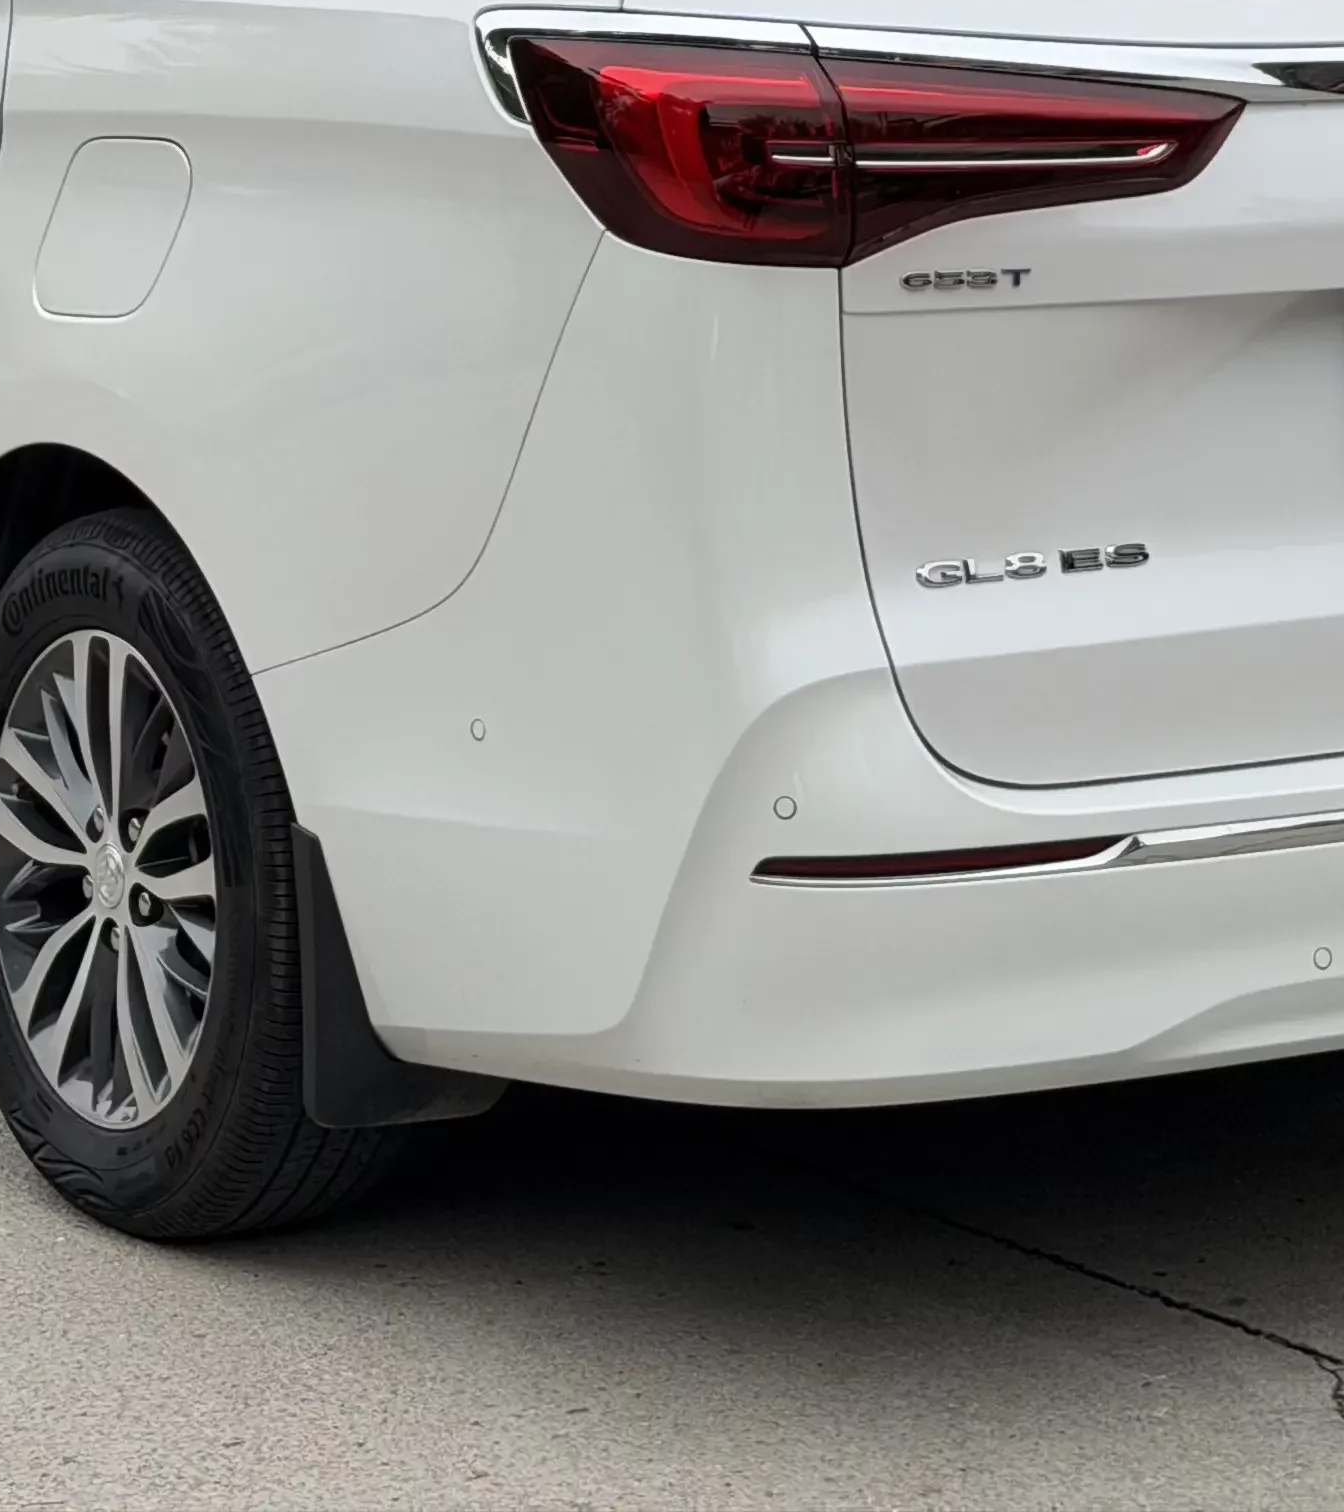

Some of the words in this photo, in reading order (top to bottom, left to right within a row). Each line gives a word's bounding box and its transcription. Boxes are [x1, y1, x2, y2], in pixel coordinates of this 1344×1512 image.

[899, 267, 1032, 292] 653T
[915, 551, 1048, 589] GL8
[1058, 542, 1151, 575] ES
[2, 565, 111, 635] Continental
